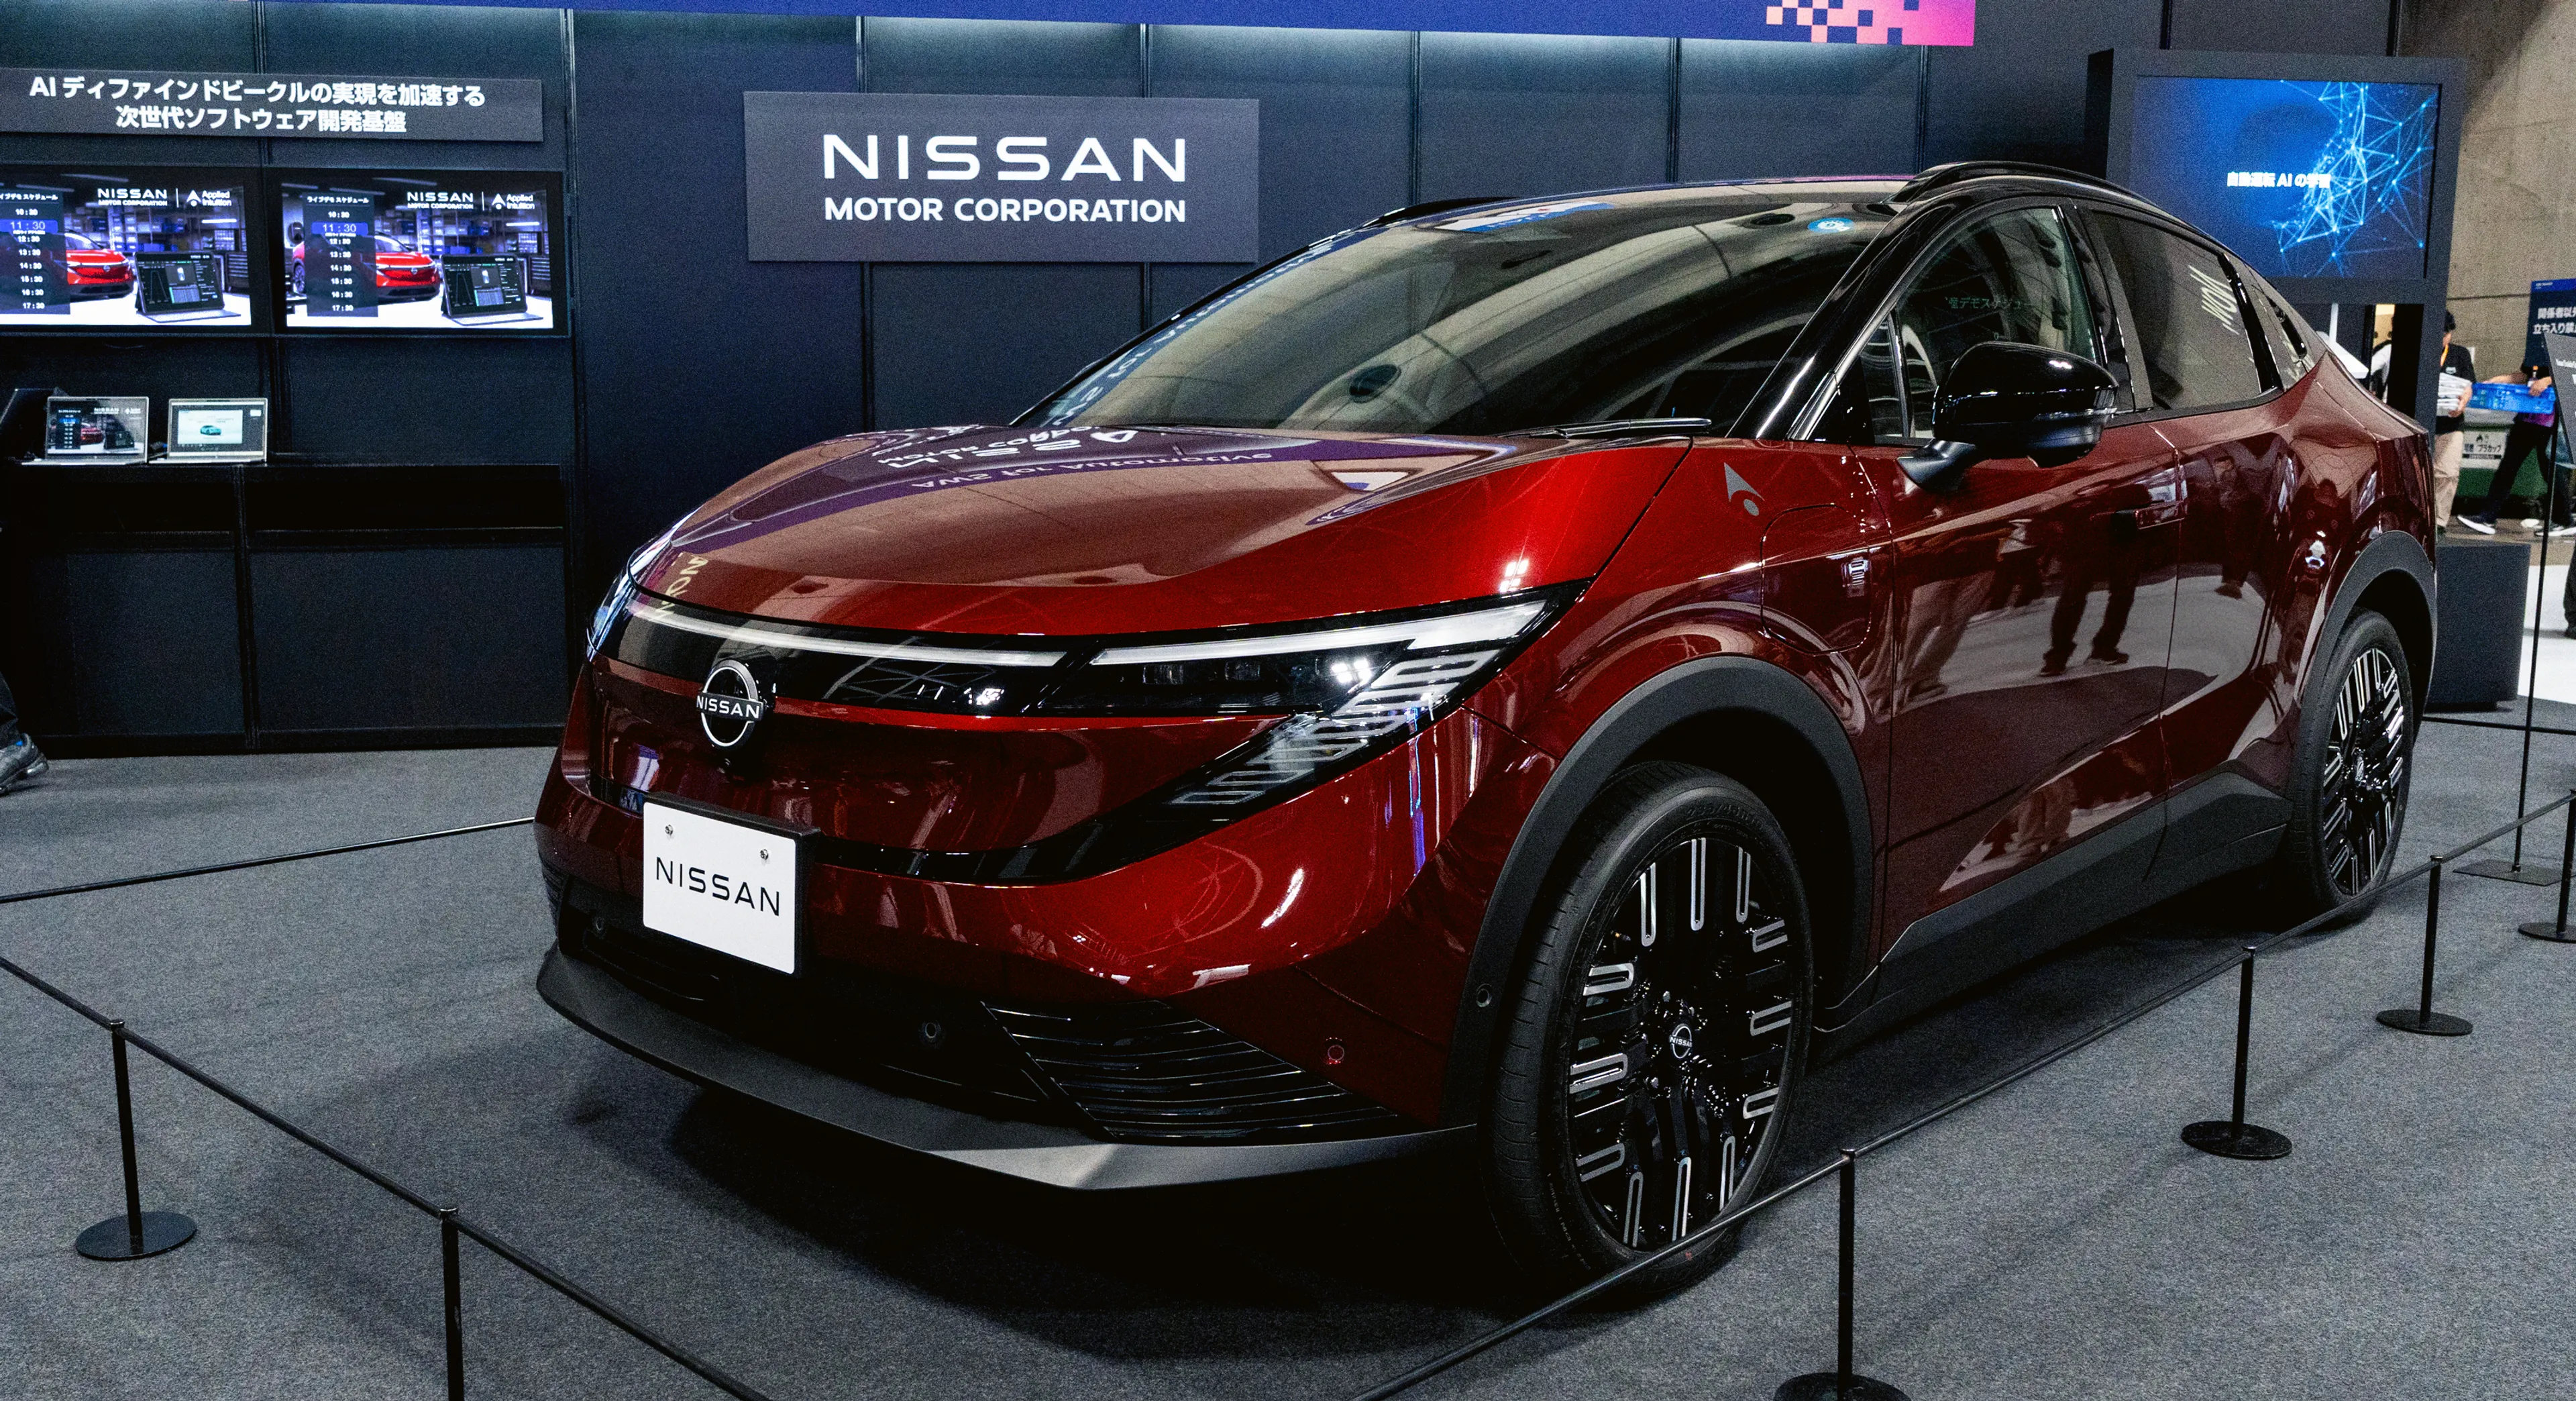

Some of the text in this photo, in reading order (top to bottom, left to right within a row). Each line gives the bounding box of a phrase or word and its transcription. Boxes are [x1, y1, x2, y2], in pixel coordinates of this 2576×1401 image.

[115, 105, 407, 133] 次世代ソフトウェア開発基盤
[823, 134, 1185, 182] NISSAN
[97, 188, 167, 199] NISSAN
[202, 191, 230, 199] Applied
[407, 192, 473, 202] NISSAN
[506, 194, 533, 202] Applied
[824, 197, 1185, 222] MOTOR CORPORATION
[10, 221, 46, 230] 11:30
[323, 223, 357, 233] 11:30
[2532, 322, 2576, 334] 立ち入り禁
[697, 694, 761, 720] NISSAN
[655, 856, 780, 917] NISSAN
[1670, 1036, 1692, 1047] NISSAN
